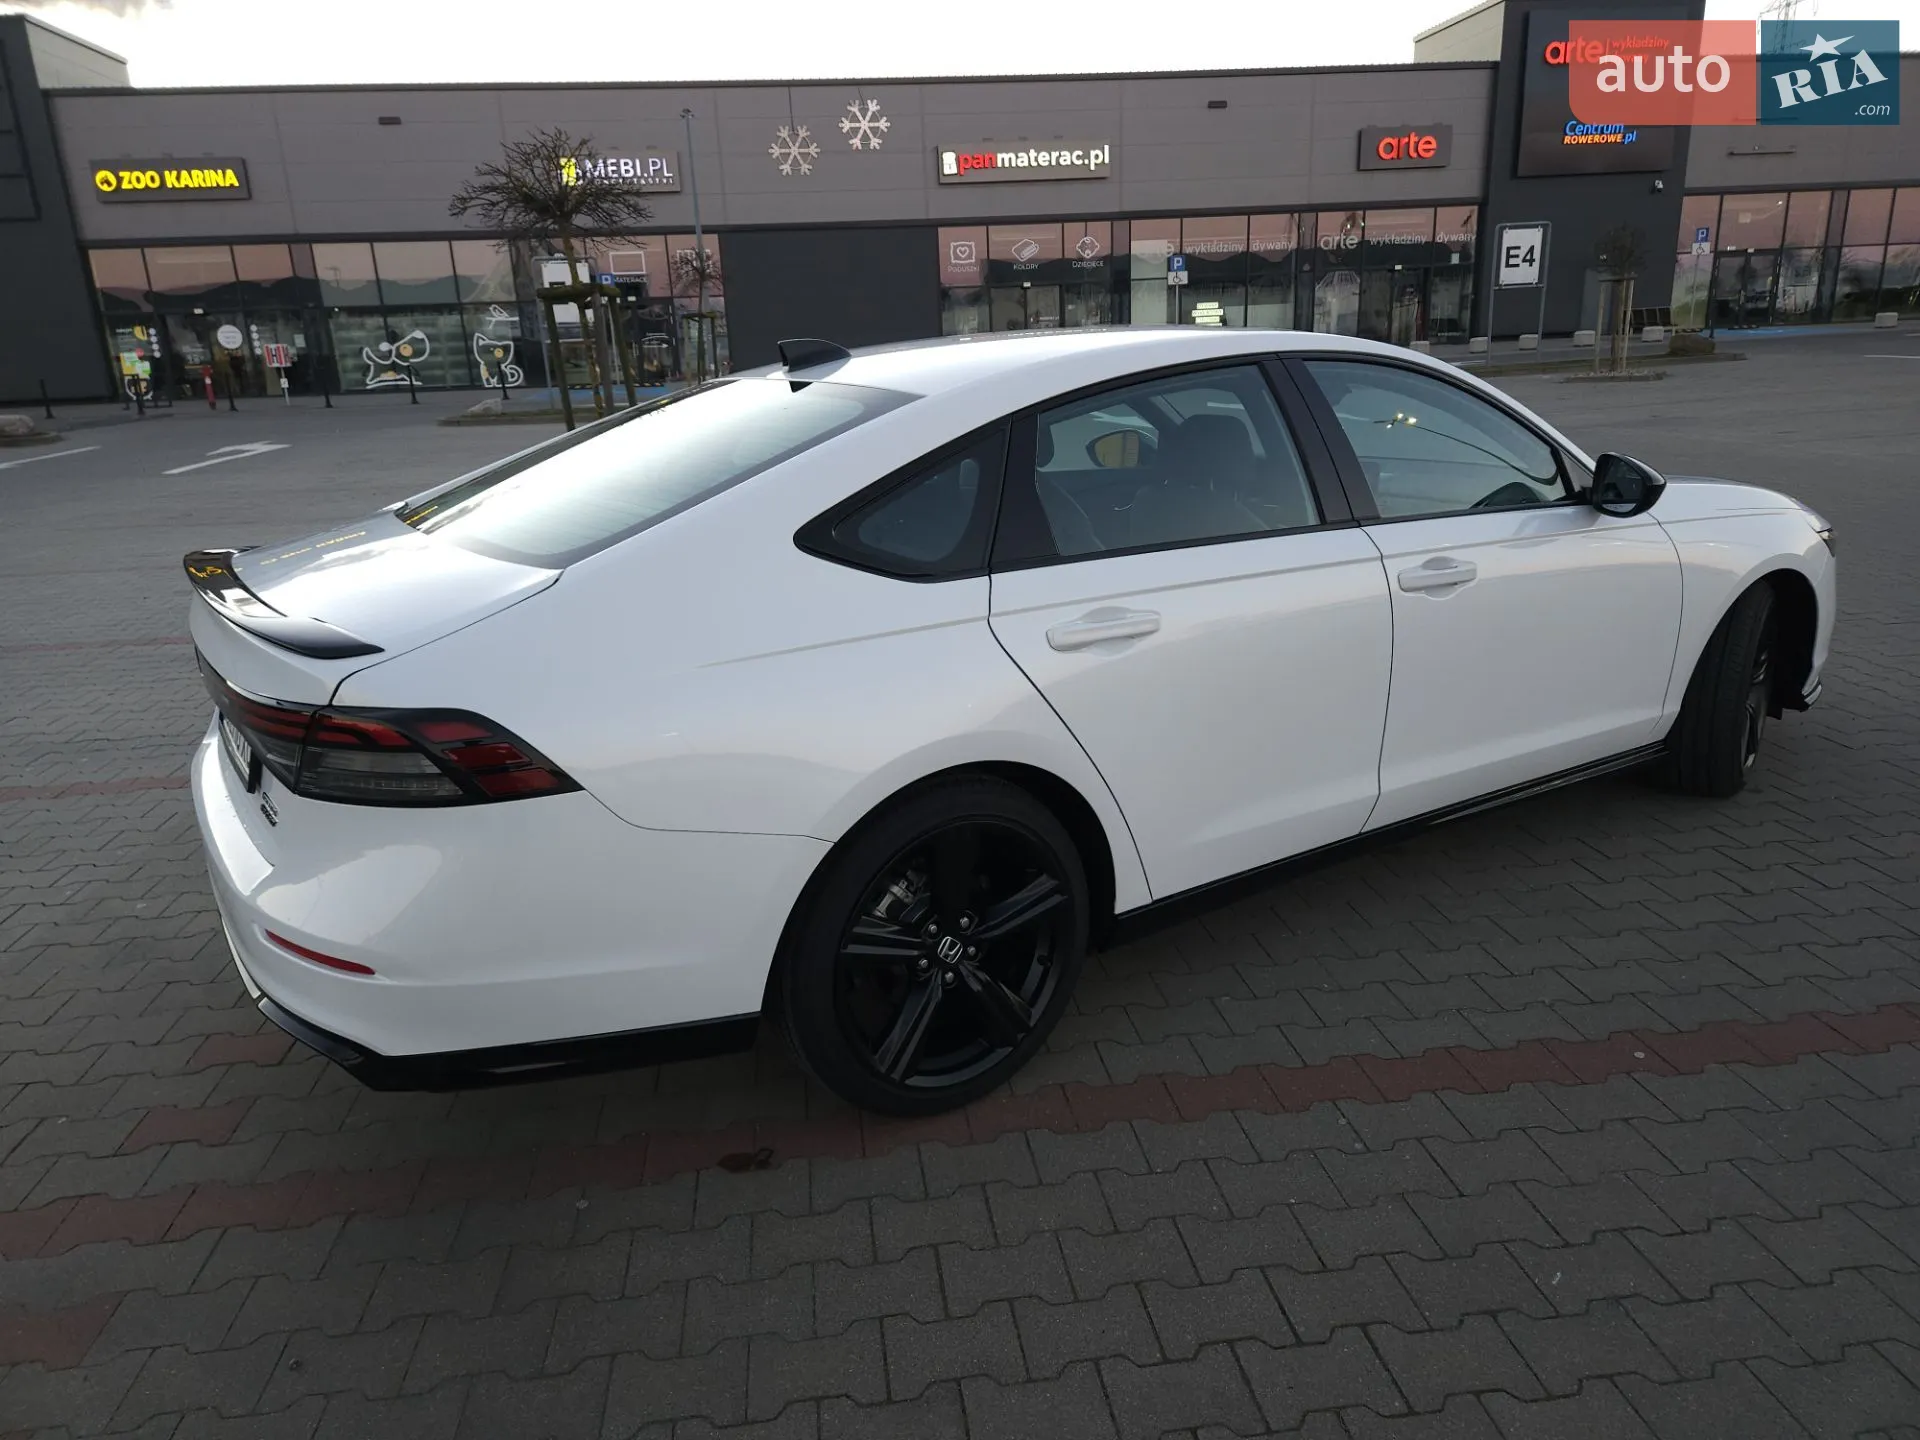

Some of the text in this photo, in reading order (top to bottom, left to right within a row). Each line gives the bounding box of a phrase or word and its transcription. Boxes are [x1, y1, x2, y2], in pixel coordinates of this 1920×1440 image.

[1544, 36, 1604, 64] arte
[1565, 120, 1624, 135] Centrum
[1377, 131, 1437, 160] arte
[958, 144, 1110, 176] panmaterac.pl
[118, 168, 240, 189] ZOO KARINA
[1184, 239, 1245, 255] wykładziny
[1251, 239, 1294, 252] dywany
[1320, 231, 1476, 250] arte wykładziny dywany
[1173, 257, 1182, 270] P
[1504, 245, 1536, 268] E4
